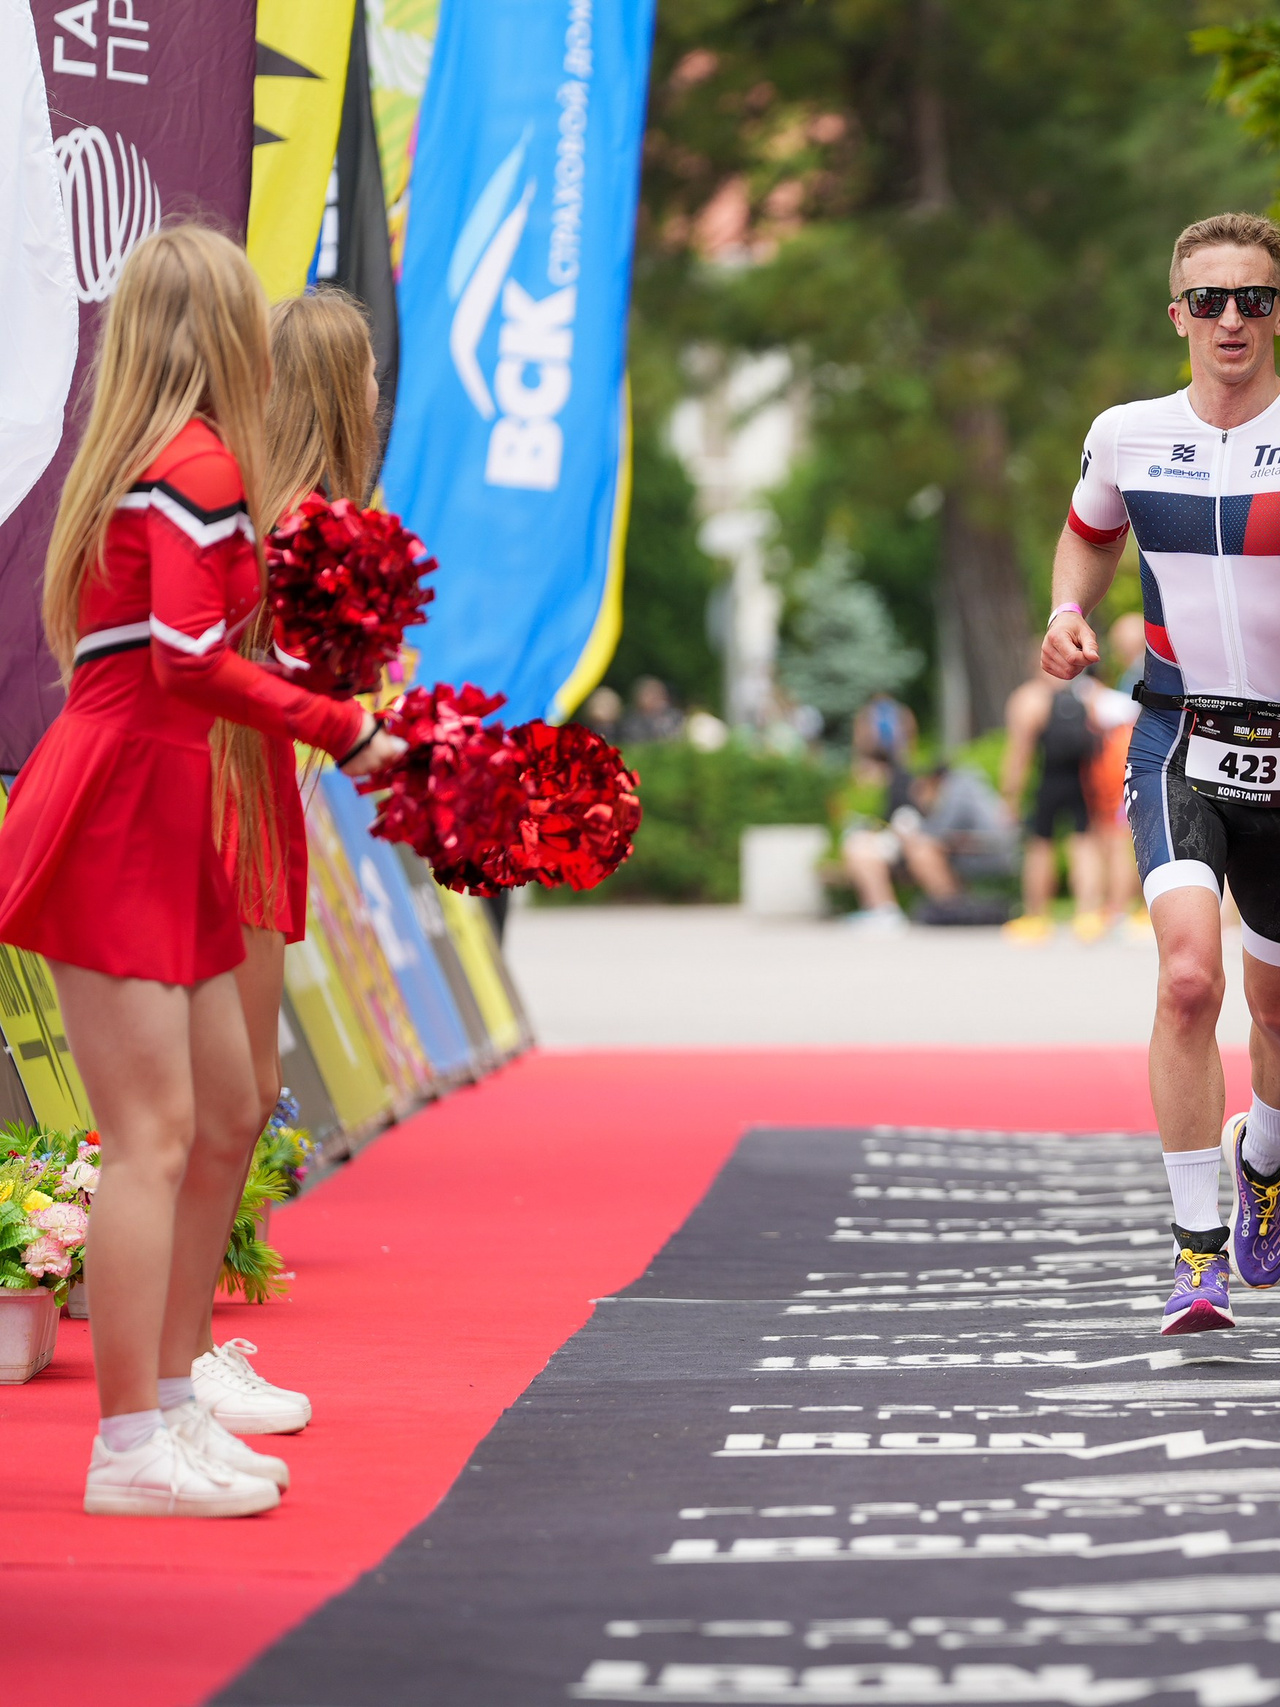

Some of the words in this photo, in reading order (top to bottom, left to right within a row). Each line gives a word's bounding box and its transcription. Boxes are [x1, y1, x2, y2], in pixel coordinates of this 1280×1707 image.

[485, 278, 577, 491] ВСК
[1184, 697, 1244, 708] performance
[1194, 703, 1225, 711] ecovery
[1233, 725, 1250, 735] IRON
[1256, 727, 1272, 736] STAR
[1218, 752, 1278, 784] 423
[1217, 786, 1271, 802] KONSTANTIN
[758, 1350, 1078, 1368] IRON
[724, 1432, 1086, 1449] IRON
[669, 1533, 1091, 1558] IRON
